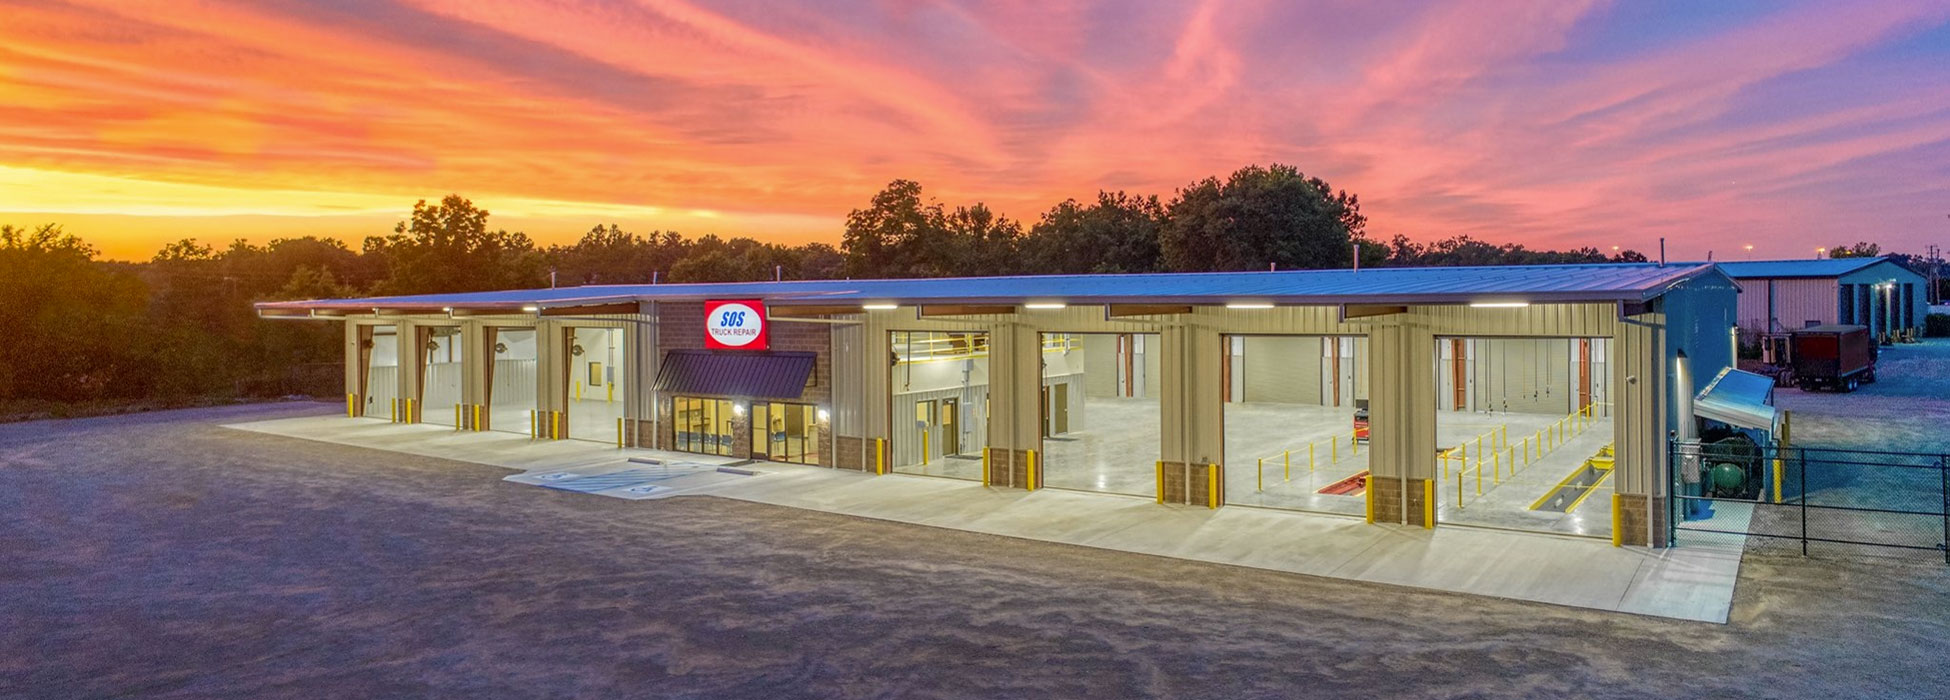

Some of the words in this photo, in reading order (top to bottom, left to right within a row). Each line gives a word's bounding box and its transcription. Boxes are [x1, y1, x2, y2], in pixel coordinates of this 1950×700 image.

[720, 311, 746, 327] SOS
[711, 328, 732, 336] TRUCK
[733, 328, 757, 336] REPAIR
